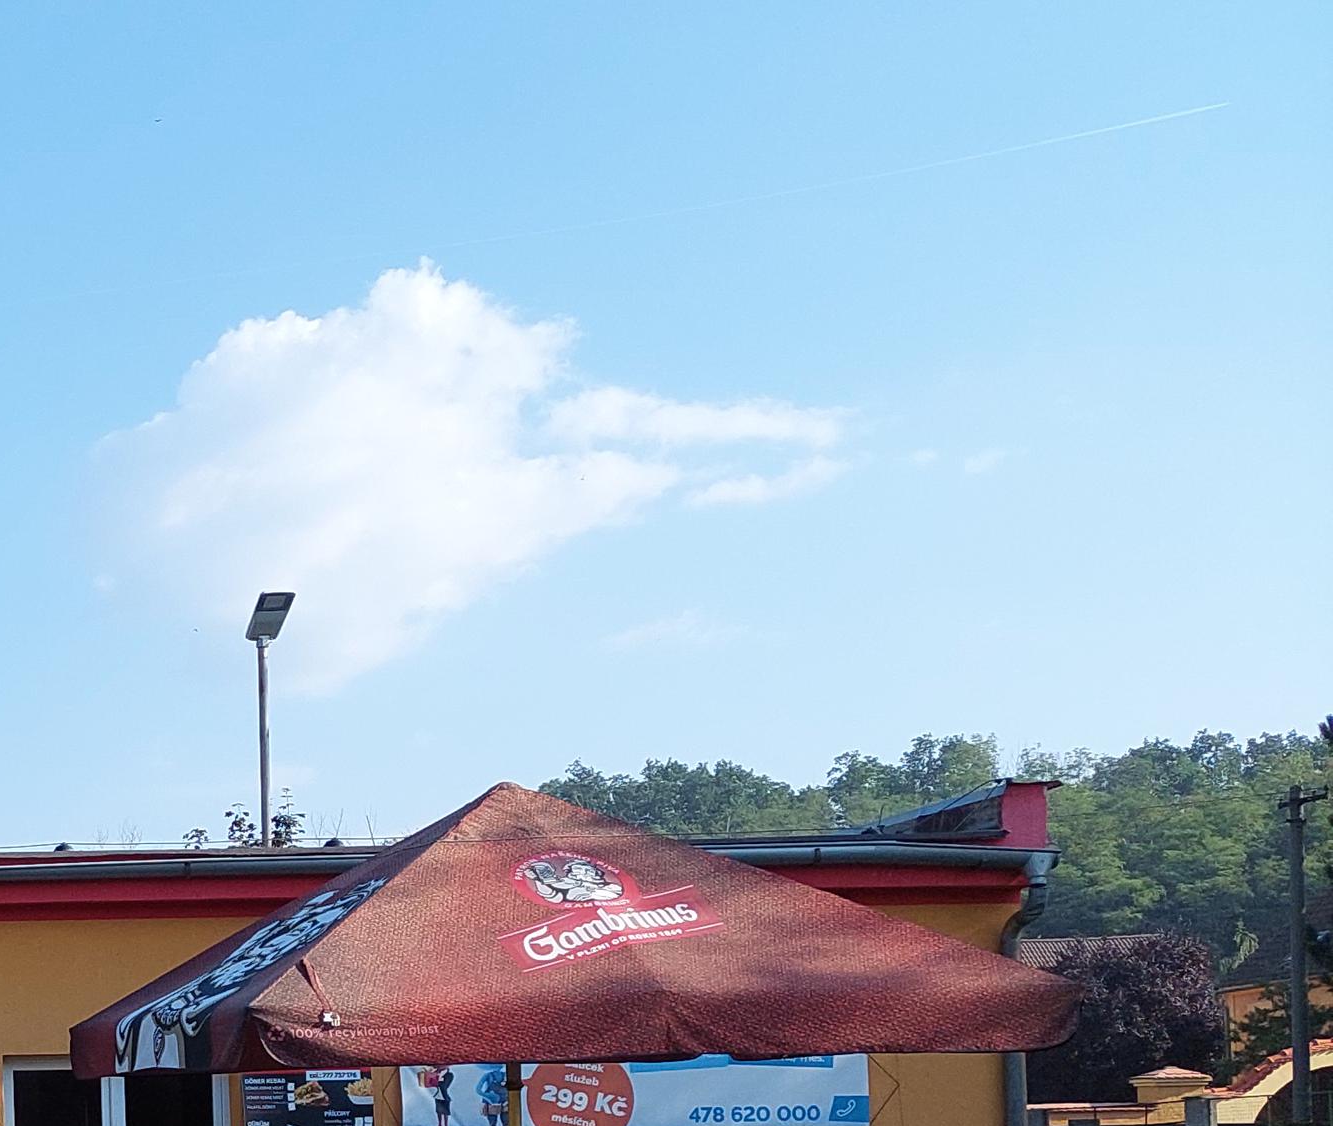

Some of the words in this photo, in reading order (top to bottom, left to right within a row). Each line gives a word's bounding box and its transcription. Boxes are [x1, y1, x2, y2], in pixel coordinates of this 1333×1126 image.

[595, 860, 621, 875] PIVA
[522, 903, 698, 962] Gambrinus
[565, 952, 575, 960] V
[611, 934, 628, 946] OD
[628, 930, 657, 942] ROKU
[291, 1028, 324, 1039] 100%
[408, 1023, 440, 1037] plast
[564, 1073, 600, 1086] služeb
[540, 1084, 589, 1112] 299
[594, 1091, 629, 1117] Kč
[689, 1105, 725, 1124] 478
[731, 1105, 771, 1124] 620
[776, 1104, 821, 1123] 000
